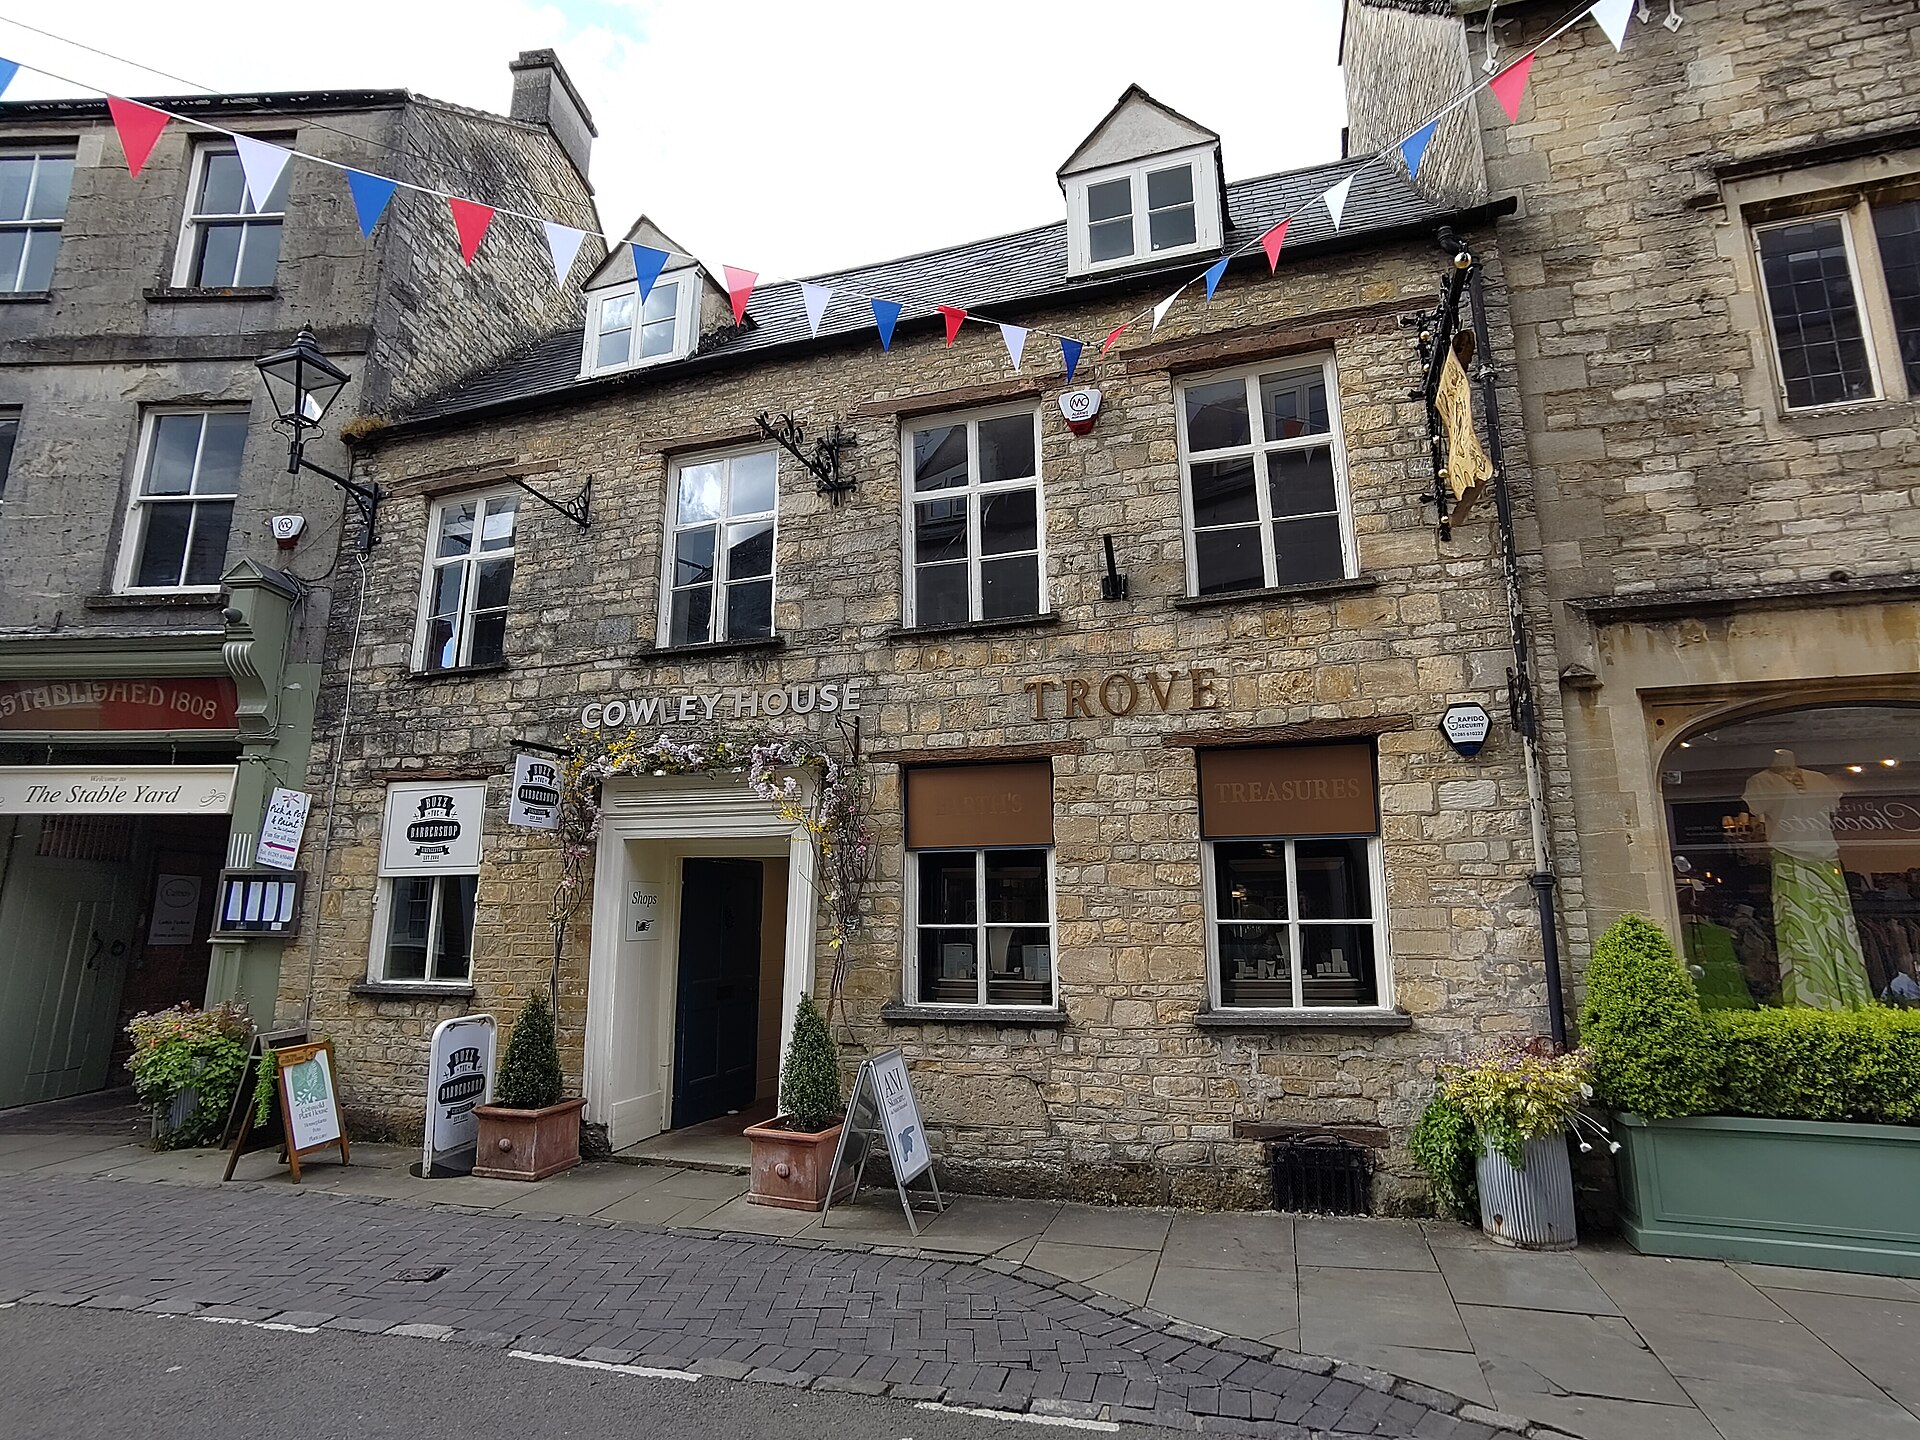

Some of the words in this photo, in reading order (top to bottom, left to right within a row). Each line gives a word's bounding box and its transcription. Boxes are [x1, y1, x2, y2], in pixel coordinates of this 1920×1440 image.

[0, 681, 164, 719] STABLISHED
[170, 690, 218, 720] 1808
[1024, 667, 1217, 721] TROVE
[581, 693, 722, 729] COWLEY
[734, 682, 862, 718] HOUSE
[1457, 715, 1485, 723] RAPIDO
[533, 765, 552, 777] BUZZ
[25, 785, 62, 803] The
[65, 785, 127, 803] Stable
[132, 785, 183, 803] Yard
[521, 788, 557, 805] BARBERSHOP
[1214, 777, 1361, 803] TREASURES
[270, 803, 285, 815] Pick
[294, 809, 307, 819] Pot
[425, 796, 449, 809] BUZZ
[410, 825, 458, 838] BARBERSHOP
[632, 891, 657, 908] Shops
[454, 1049, 475, 1064] BUZZ
[441, 1078, 483, 1101] BARBERSHOP
[299, 1111, 312, 1120] Plant
